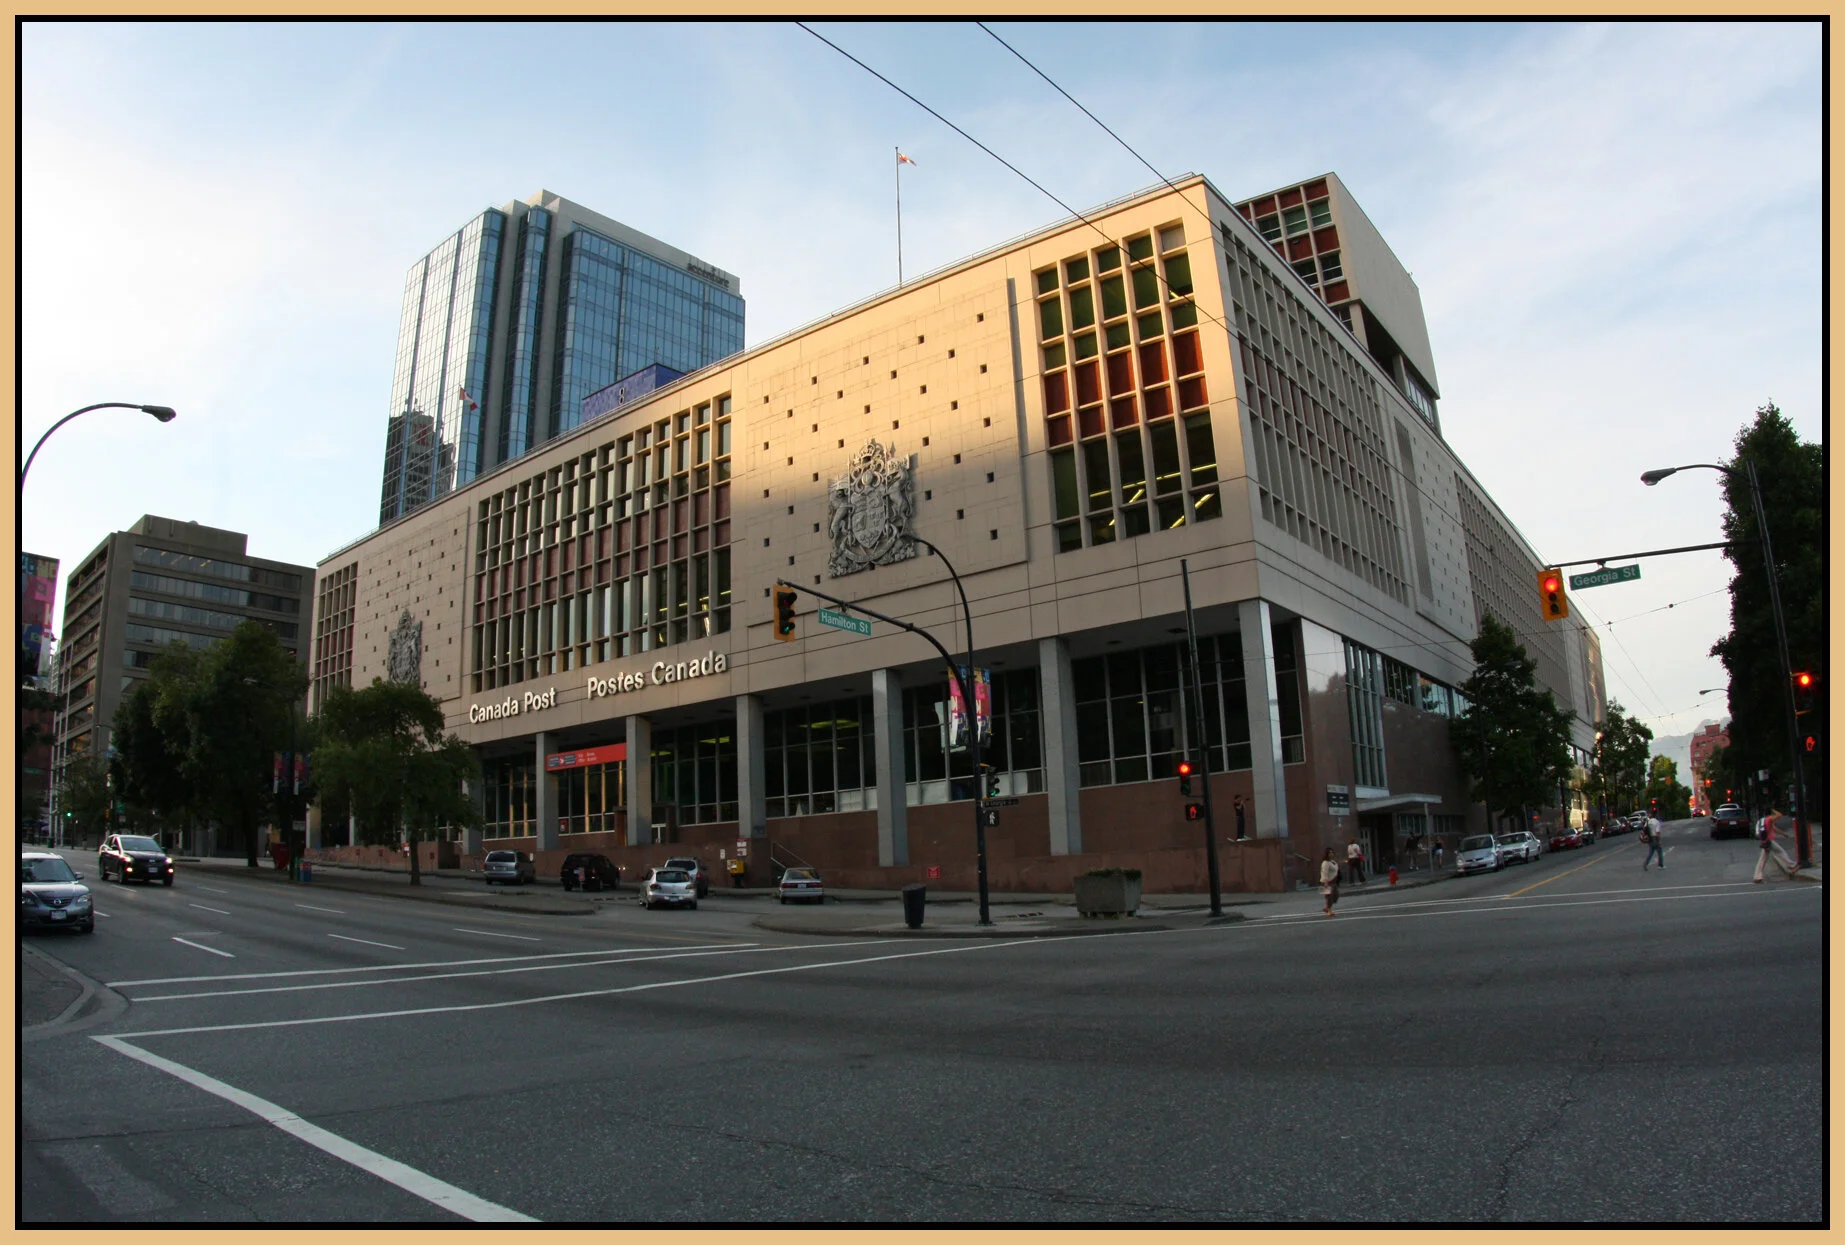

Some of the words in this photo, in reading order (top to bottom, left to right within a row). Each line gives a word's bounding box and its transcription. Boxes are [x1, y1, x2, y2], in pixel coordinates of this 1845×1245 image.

[1574, 571, 1618, 586] Georgia
[1623, 567, 1636, 578] St
[821, 612, 857, 630] Hamilton
[859, 622, 869, 633] St
[469, 697, 519, 724] Canada
[524, 687, 557, 713] Post
[587, 671, 645, 700] Postes
[651, 650, 727, 685] Canada
